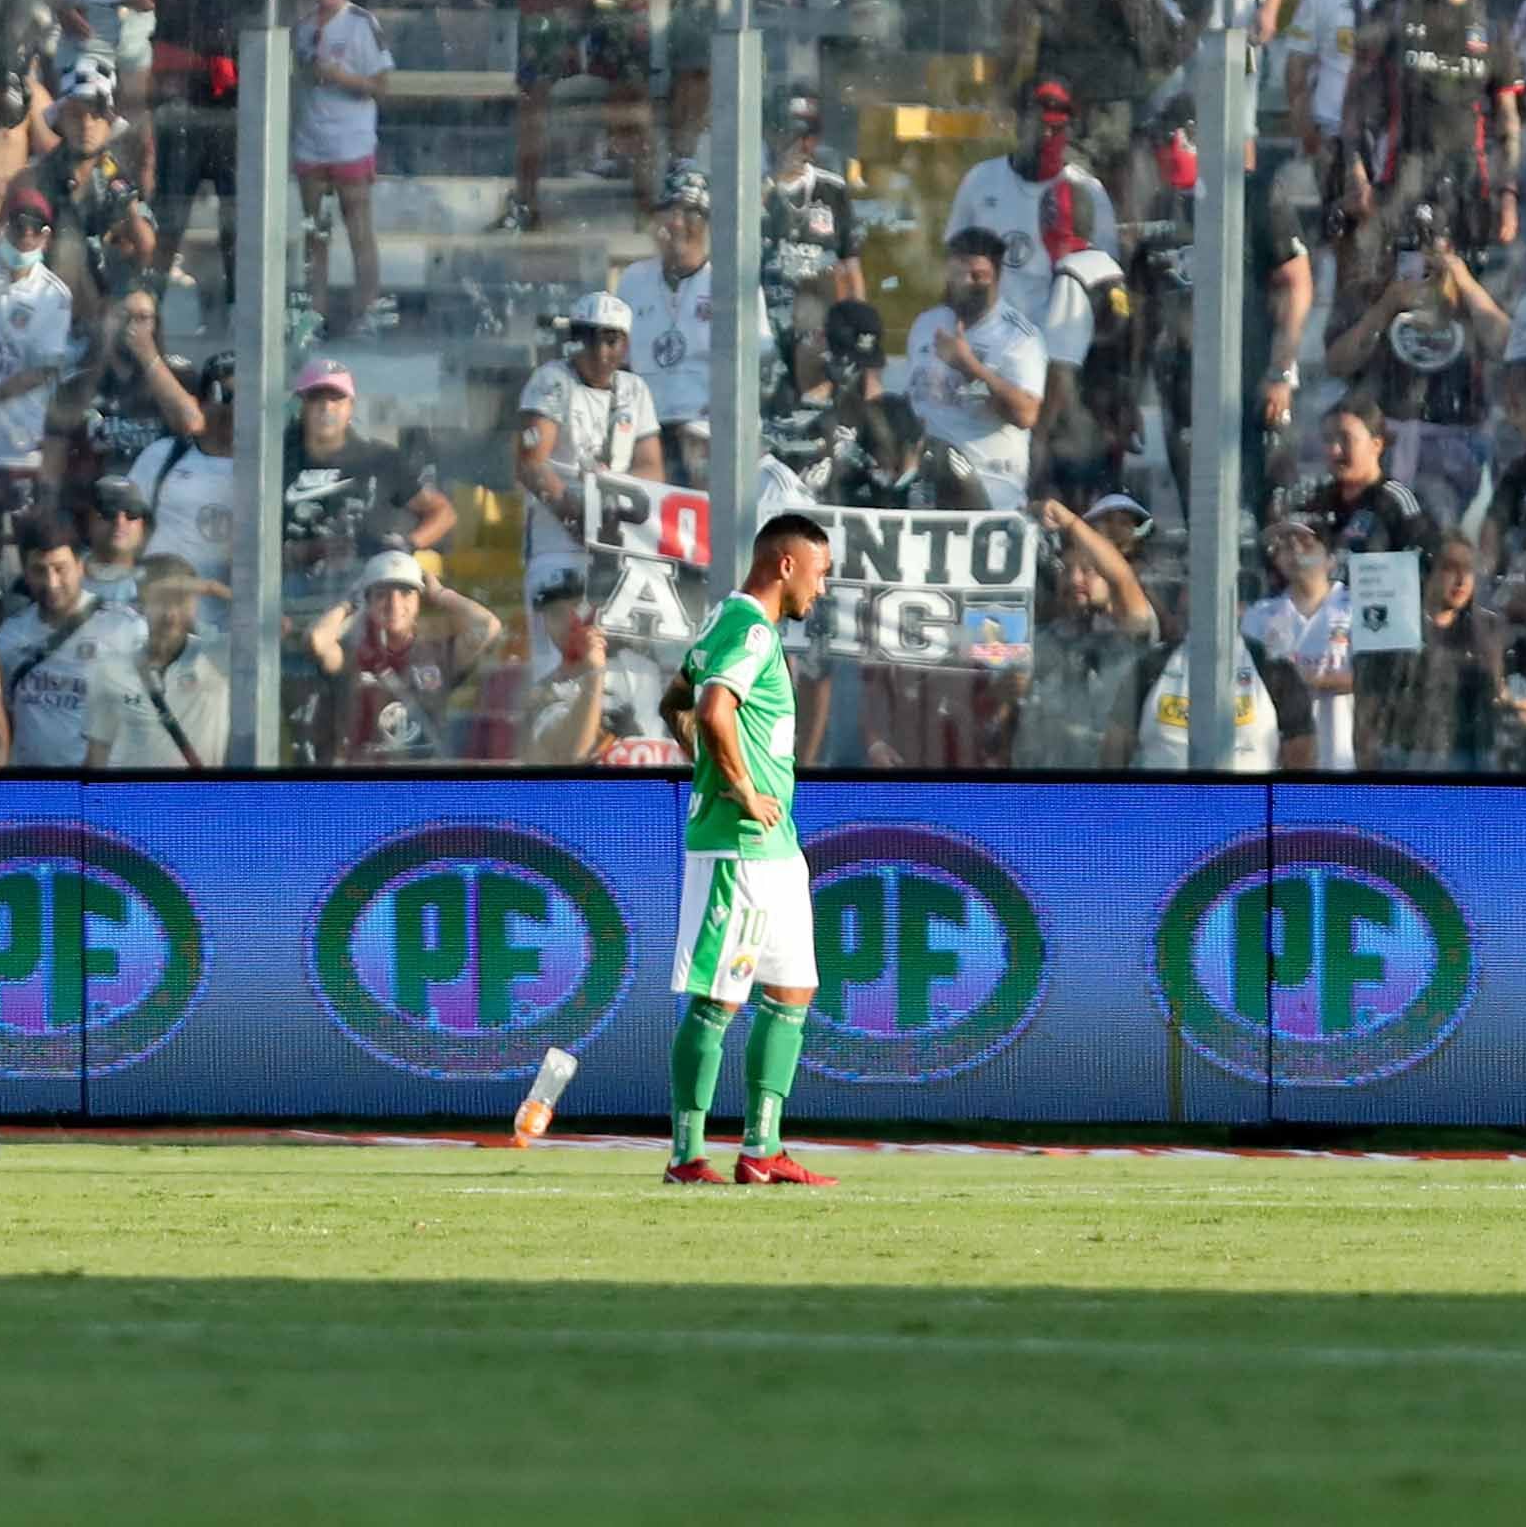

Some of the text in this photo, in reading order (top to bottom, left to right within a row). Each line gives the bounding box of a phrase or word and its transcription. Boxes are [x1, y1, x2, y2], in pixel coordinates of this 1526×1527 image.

[393, 870, 548, 1028] PF
[739, 907, 767, 946] 10
[817, 871, 969, 1032] PF
[1234, 875, 1396, 1035] PF
